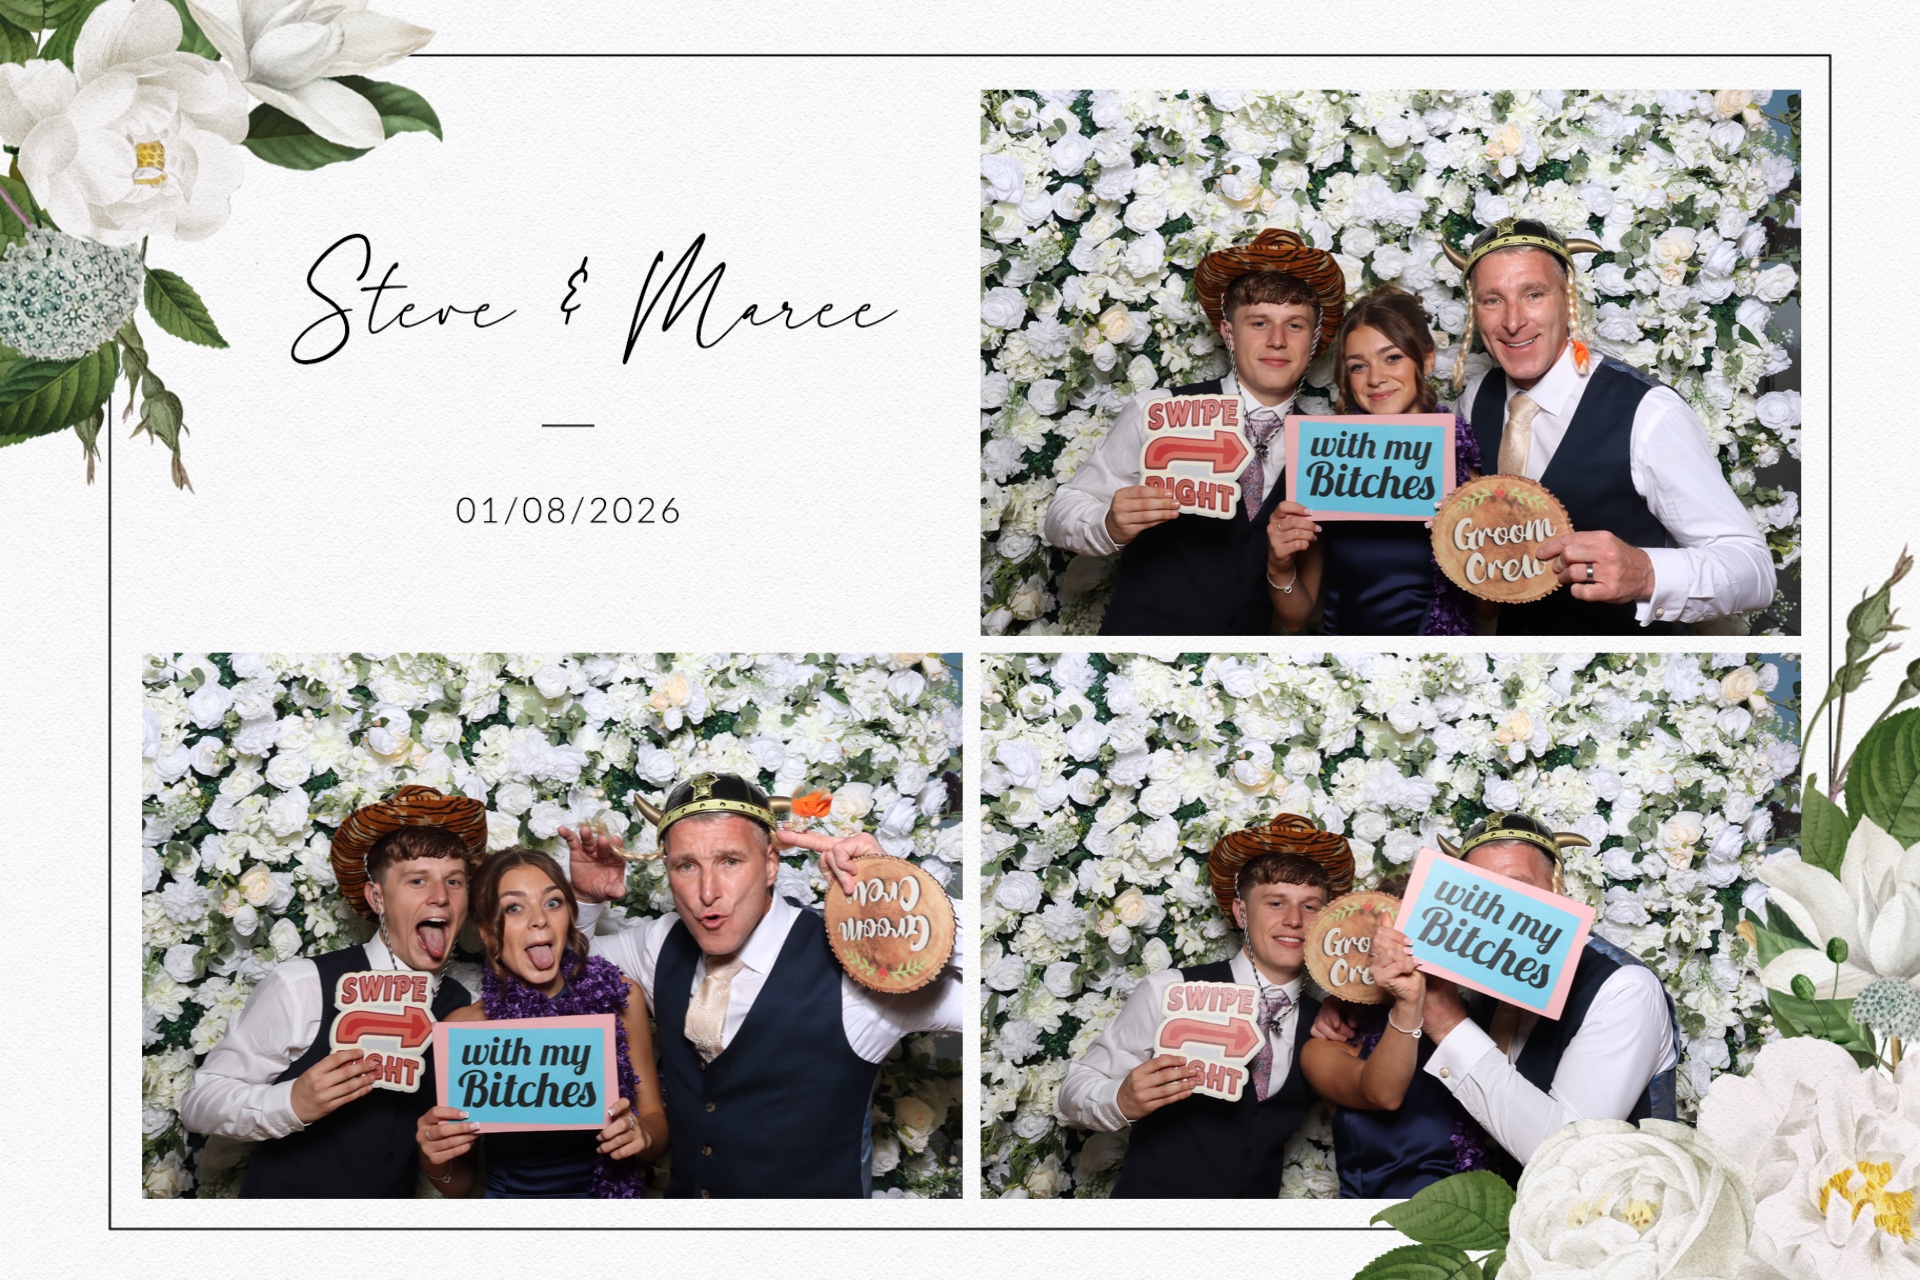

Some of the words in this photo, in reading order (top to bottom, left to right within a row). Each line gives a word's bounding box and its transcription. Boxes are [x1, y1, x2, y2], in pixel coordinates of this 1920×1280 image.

[1148, 399, 1239, 431] SWIPE
[1310, 431, 1376, 460] with
[1383, 440, 1432, 470] my
[1306, 461, 1436, 500] Bitches
[1454, 517, 1557, 550] Groom
[1465, 552, 1550, 585] Crew
[838, 914, 930, 952] Groom
[1434, 880, 1505, 924] with
[1507, 911, 1563, 955] my
[1323, 927, 1371, 957] Gro
[1417, 906, 1551, 989] Bitches
[341, 974, 428, 1005] SWIPE
[1329, 958, 1376, 987] Cre
[1167, 985, 1255, 1015] SWIPE
[461, 1037, 531, 1066] with
[539, 1044, 592, 1076] my
[458, 1069, 597, 1108] Bitches
